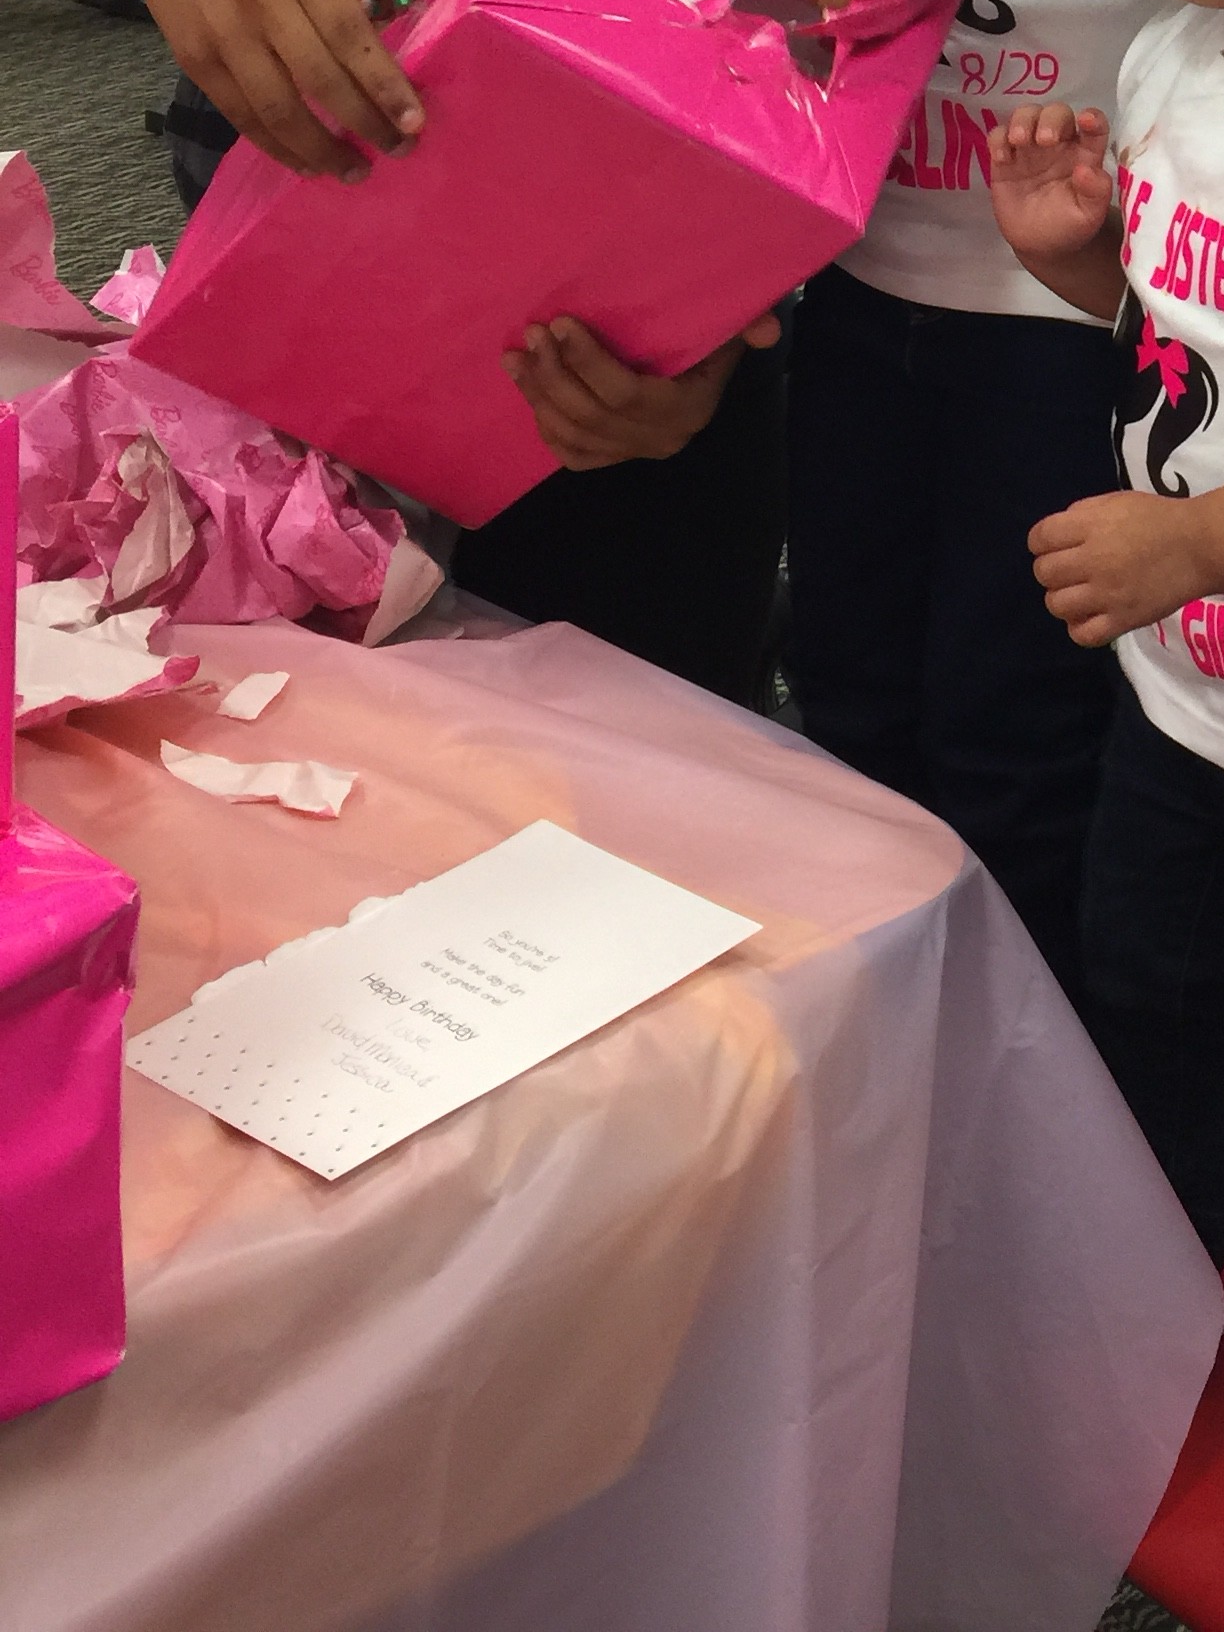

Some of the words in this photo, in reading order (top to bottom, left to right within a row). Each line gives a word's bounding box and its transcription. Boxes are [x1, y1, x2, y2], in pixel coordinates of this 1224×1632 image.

[959, 49, 1060, 96] 8/29
[445, 976, 482, 994] great
[467, 963, 486, 976] the
[360, 972, 412, 1006] Happy
[408, 999, 480, 1042] Birthday
